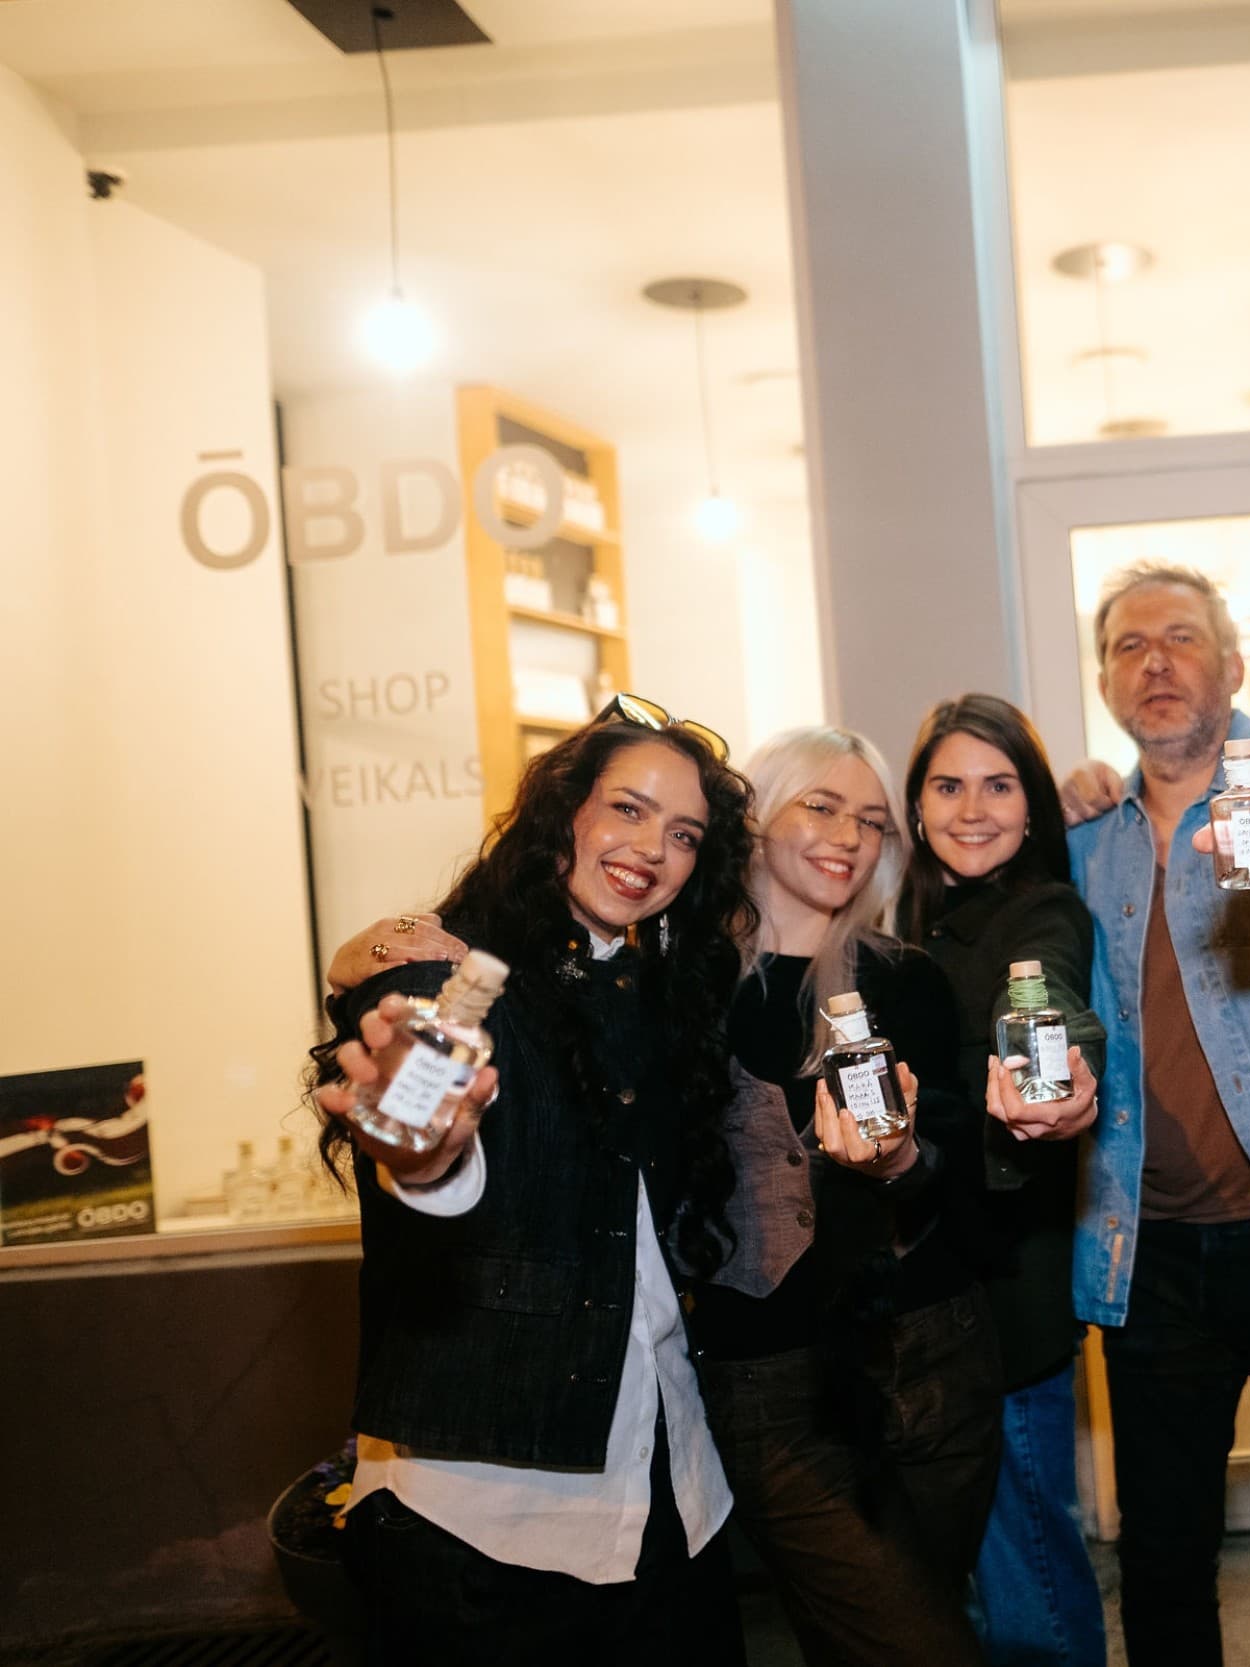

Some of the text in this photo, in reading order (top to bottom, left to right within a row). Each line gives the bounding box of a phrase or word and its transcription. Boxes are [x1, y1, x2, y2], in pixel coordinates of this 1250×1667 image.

[180, 442, 564, 573] ŌBDO
[319, 669, 450, 721] SHOP
[298, 754, 487, 808] VEIKALS
